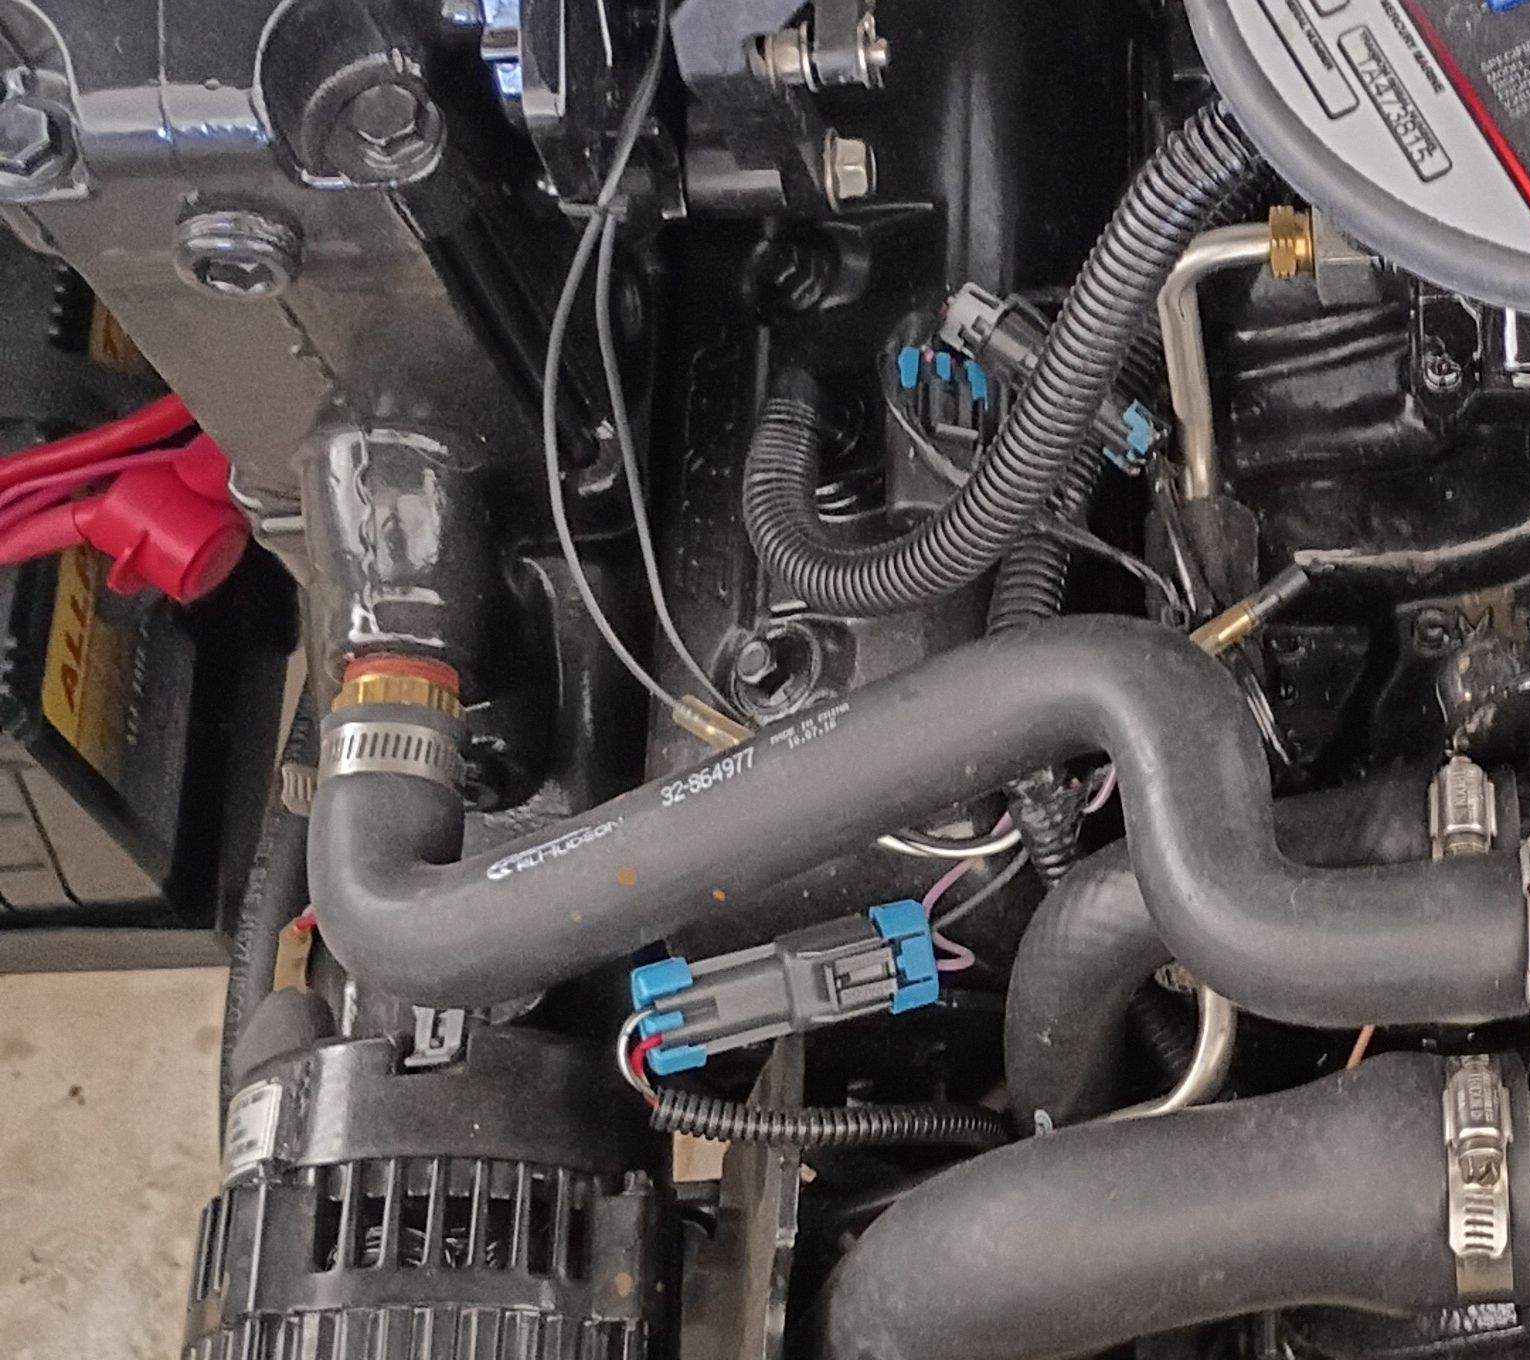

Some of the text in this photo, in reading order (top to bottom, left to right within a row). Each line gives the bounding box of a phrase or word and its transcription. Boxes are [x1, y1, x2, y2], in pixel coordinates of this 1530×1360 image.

[1303, 28, 1335, 71] NUMBER
[1411, 49, 1445, 95] MARINE
[767, 700, 851, 746] MADE IN CHINA
